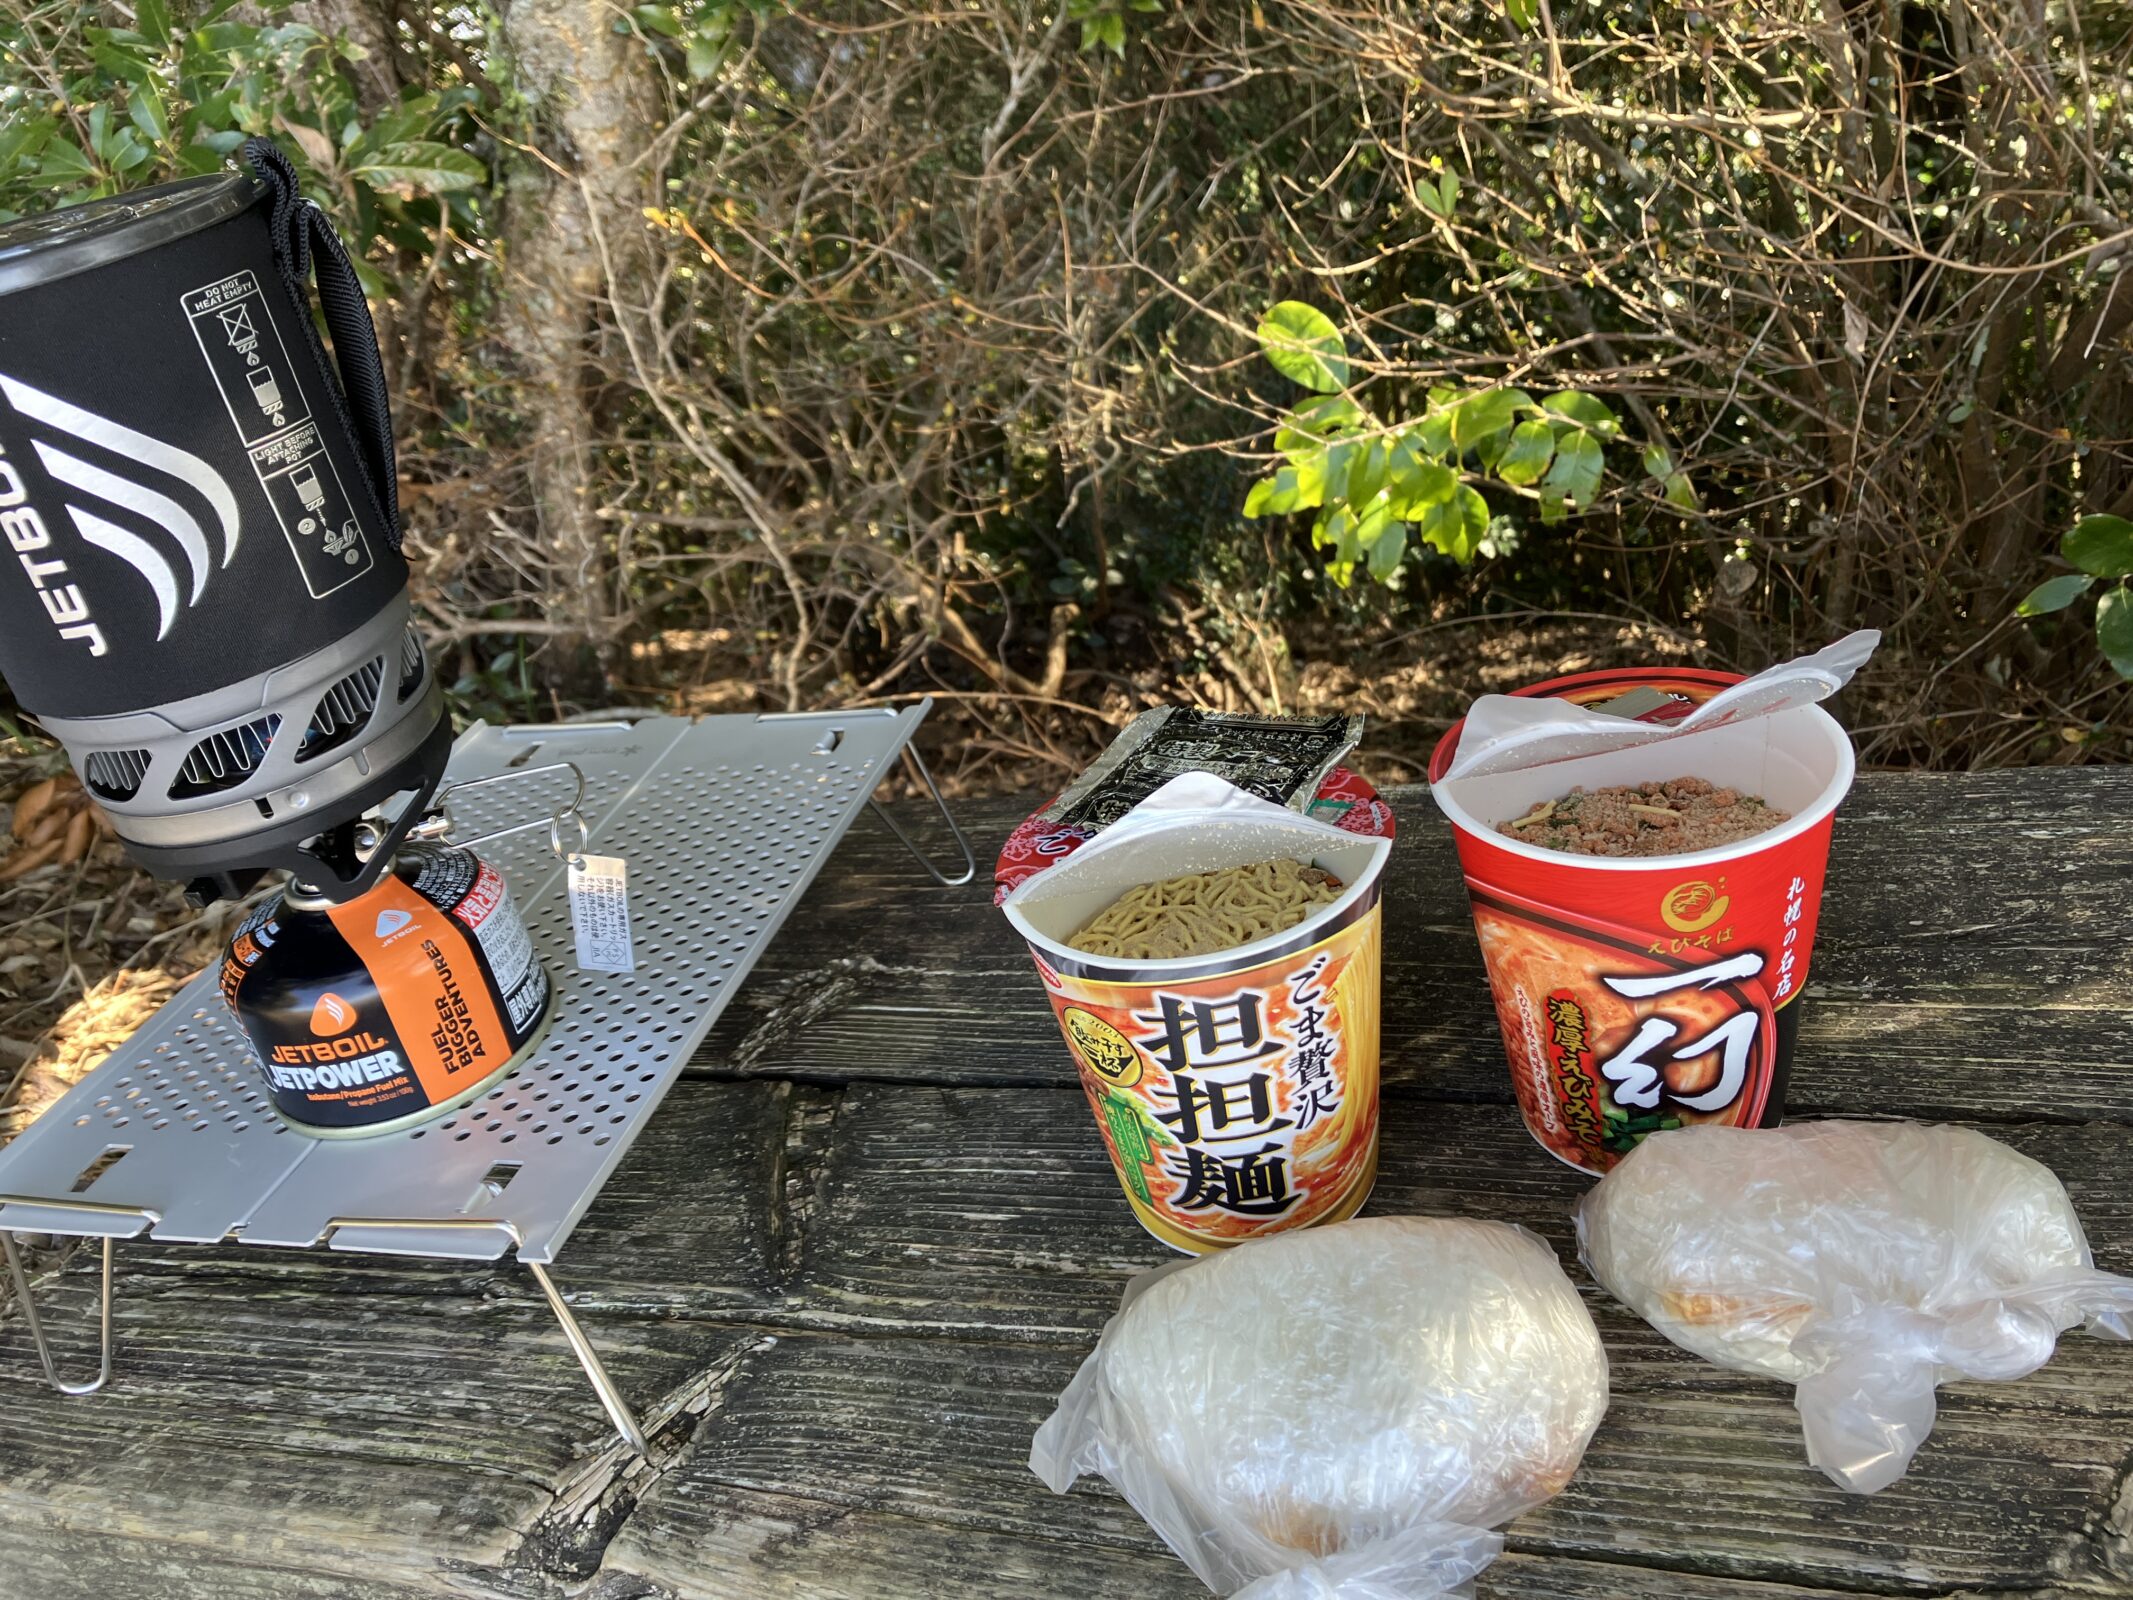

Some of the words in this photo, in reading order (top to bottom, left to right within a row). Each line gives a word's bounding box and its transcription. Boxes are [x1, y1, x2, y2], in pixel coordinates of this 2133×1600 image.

[194, 294, 222, 312] HEAT
[224, 281, 253, 300] EMPTY
[206, 286, 220, 298] DO
[221, 278, 240, 292] NOT
[254, 443, 285, 461] LIGHT
[285, 427, 316, 450] BEFORE
[268, 438, 315, 465] ATTACHING
[286, 452, 302, 464] POT
[381, 924, 422, 948] JETBOIL
[1648, 926, 1733, 955] えびそば
[1773, 877, 1805, 1001] 札幌の名店
[420, 939, 486, 1057] ADVENTURES
[271, 1032, 386, 1064] JETBOIL
[435, 994, 473, 1068] BIGGER
[1289, 957, 1340, 1130] ごま贅沢
[430, 1022, 460, 1075] FUEL
[268, 1050, 407, 1090] JETPOWER
[375, 1080, 394, 1093] Fuel
[393, 1076, 409, 1087] Mix
[1547, 997, 1600, 1144] 濃厚えびみそ
[1137, 992, 1302, 1215] 担担麺
